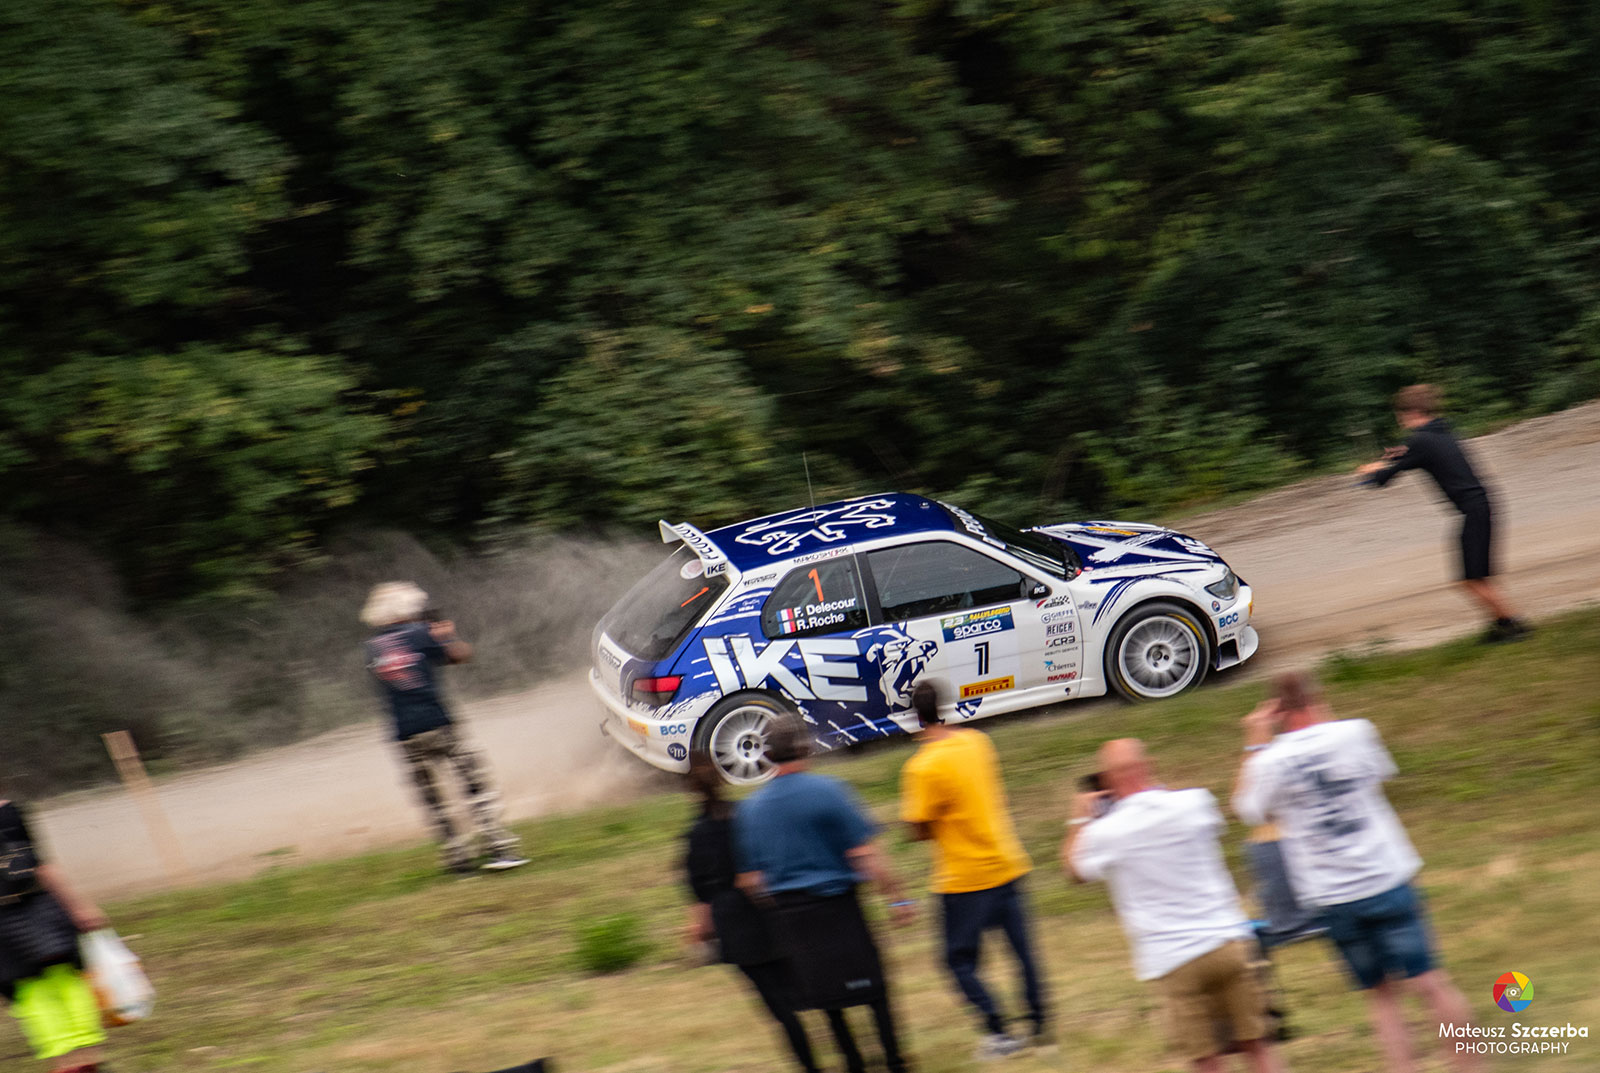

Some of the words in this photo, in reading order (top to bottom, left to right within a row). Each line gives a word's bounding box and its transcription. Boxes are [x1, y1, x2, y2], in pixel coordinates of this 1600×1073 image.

[707, 563, 726, 576] IKE
[808, 568, 824, 602] 1
[793, 607, 804, 618] F.
[806, 598, 856, 615] Delecour
[953, 619, 1001, 638] sparco
[1047, 622, 1073, 636] REIGER
[1219, 612, 1239, 628] BCC
[974, 641, 989, 676] 1
[703, 637, 868, 702] IKE
[964, 679, 1010, 696] PIRELLI
[660, 724, 687, 735] BCC
